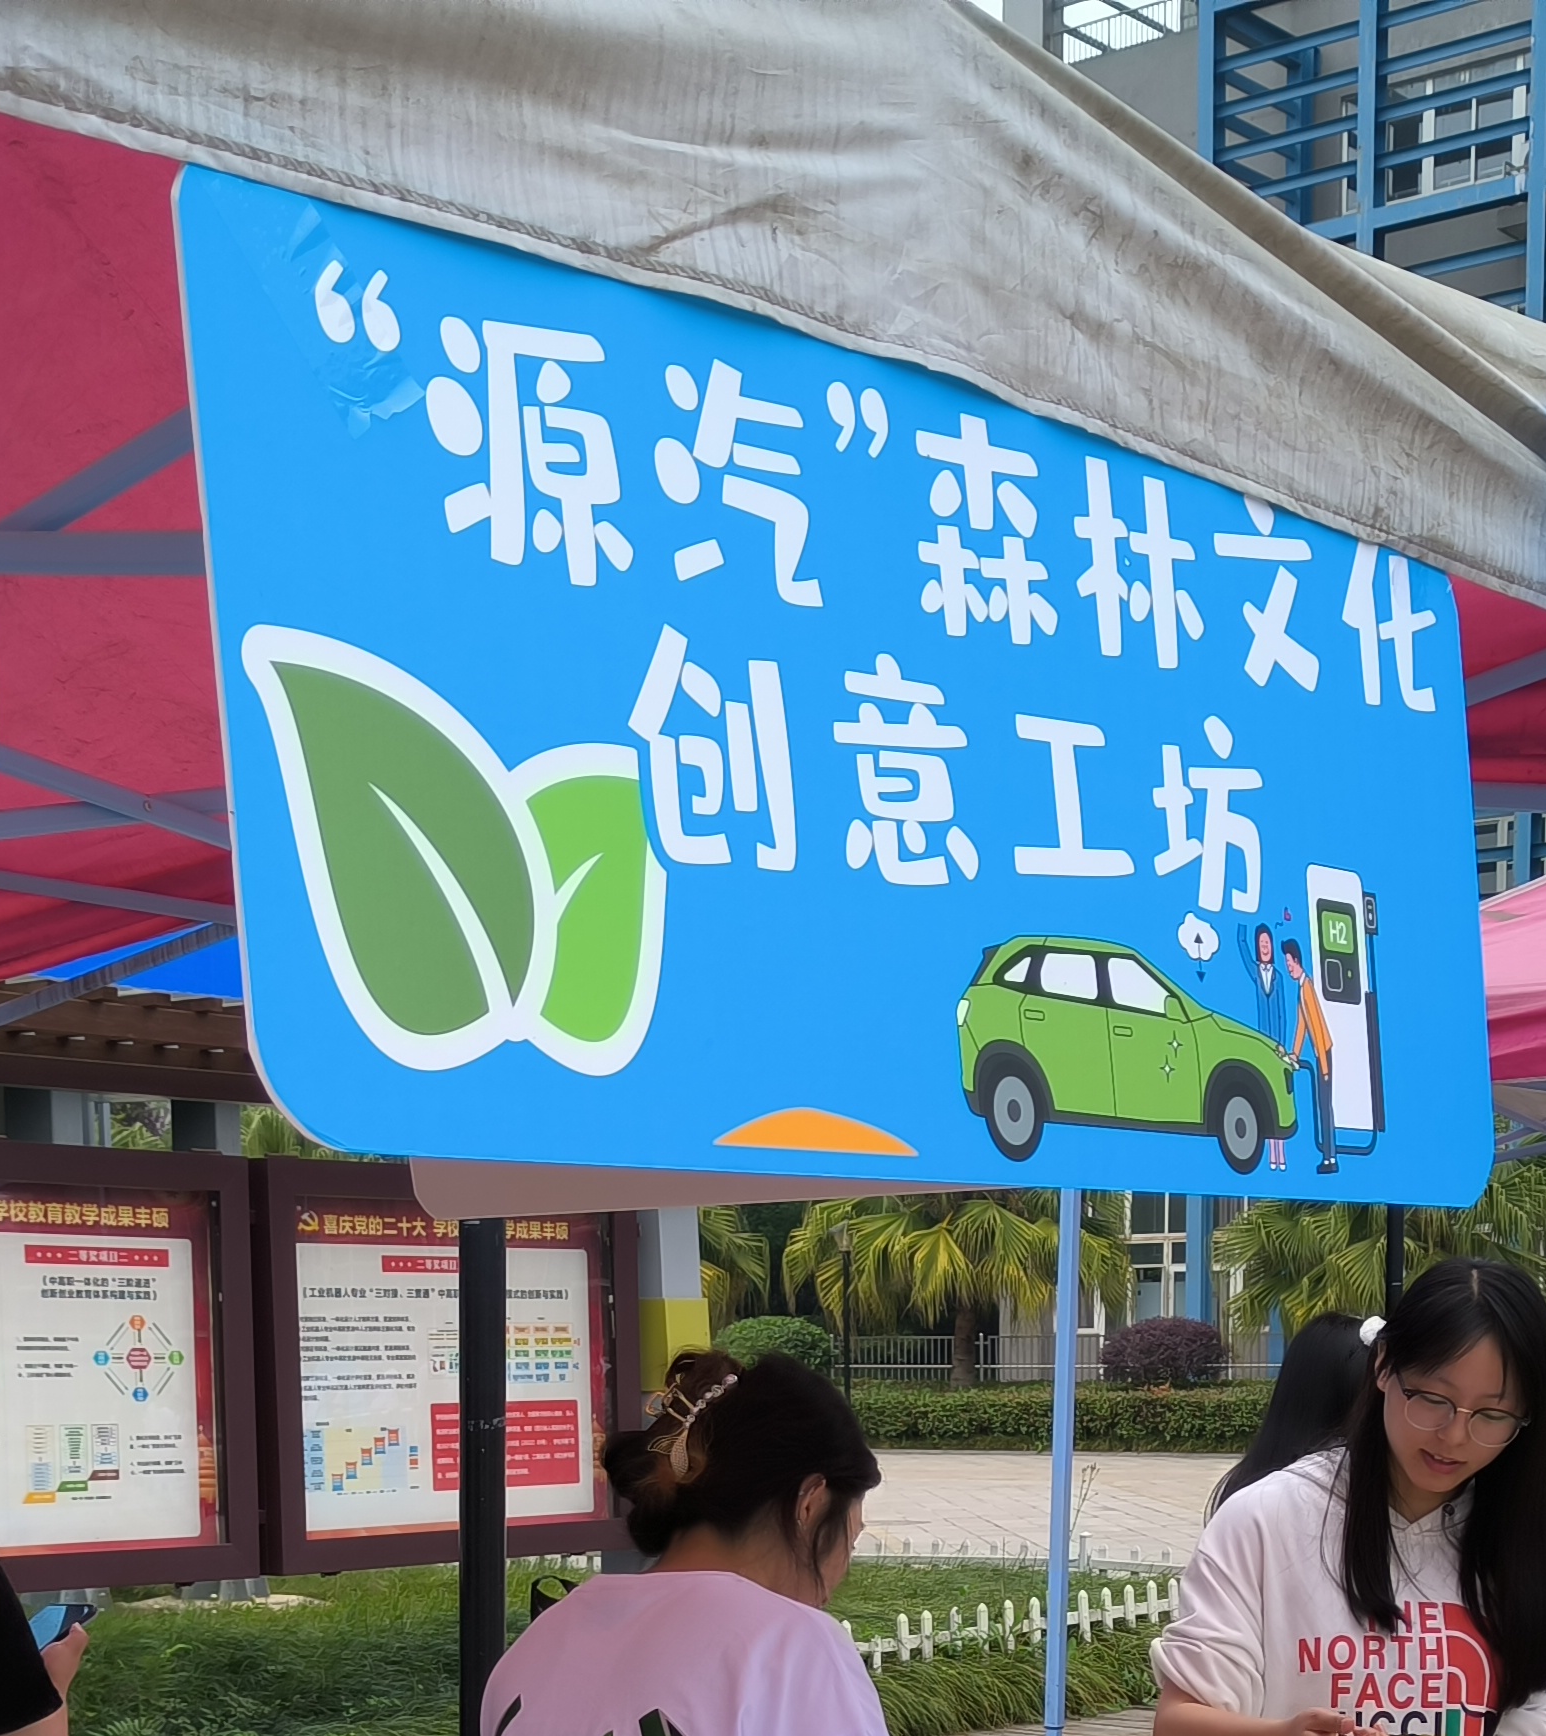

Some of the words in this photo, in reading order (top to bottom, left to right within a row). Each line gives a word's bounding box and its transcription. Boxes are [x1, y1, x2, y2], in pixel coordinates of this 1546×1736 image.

[628, 623, 1264, 914] 创意工坊
[1329, 919, 1349, 946] H2
[322, 1213, 427, 1238] 喜庆党的二十大
[1298, 1634, 1445, 1674] NORTH
[1330, 1672, 1444, 1710] FACE
